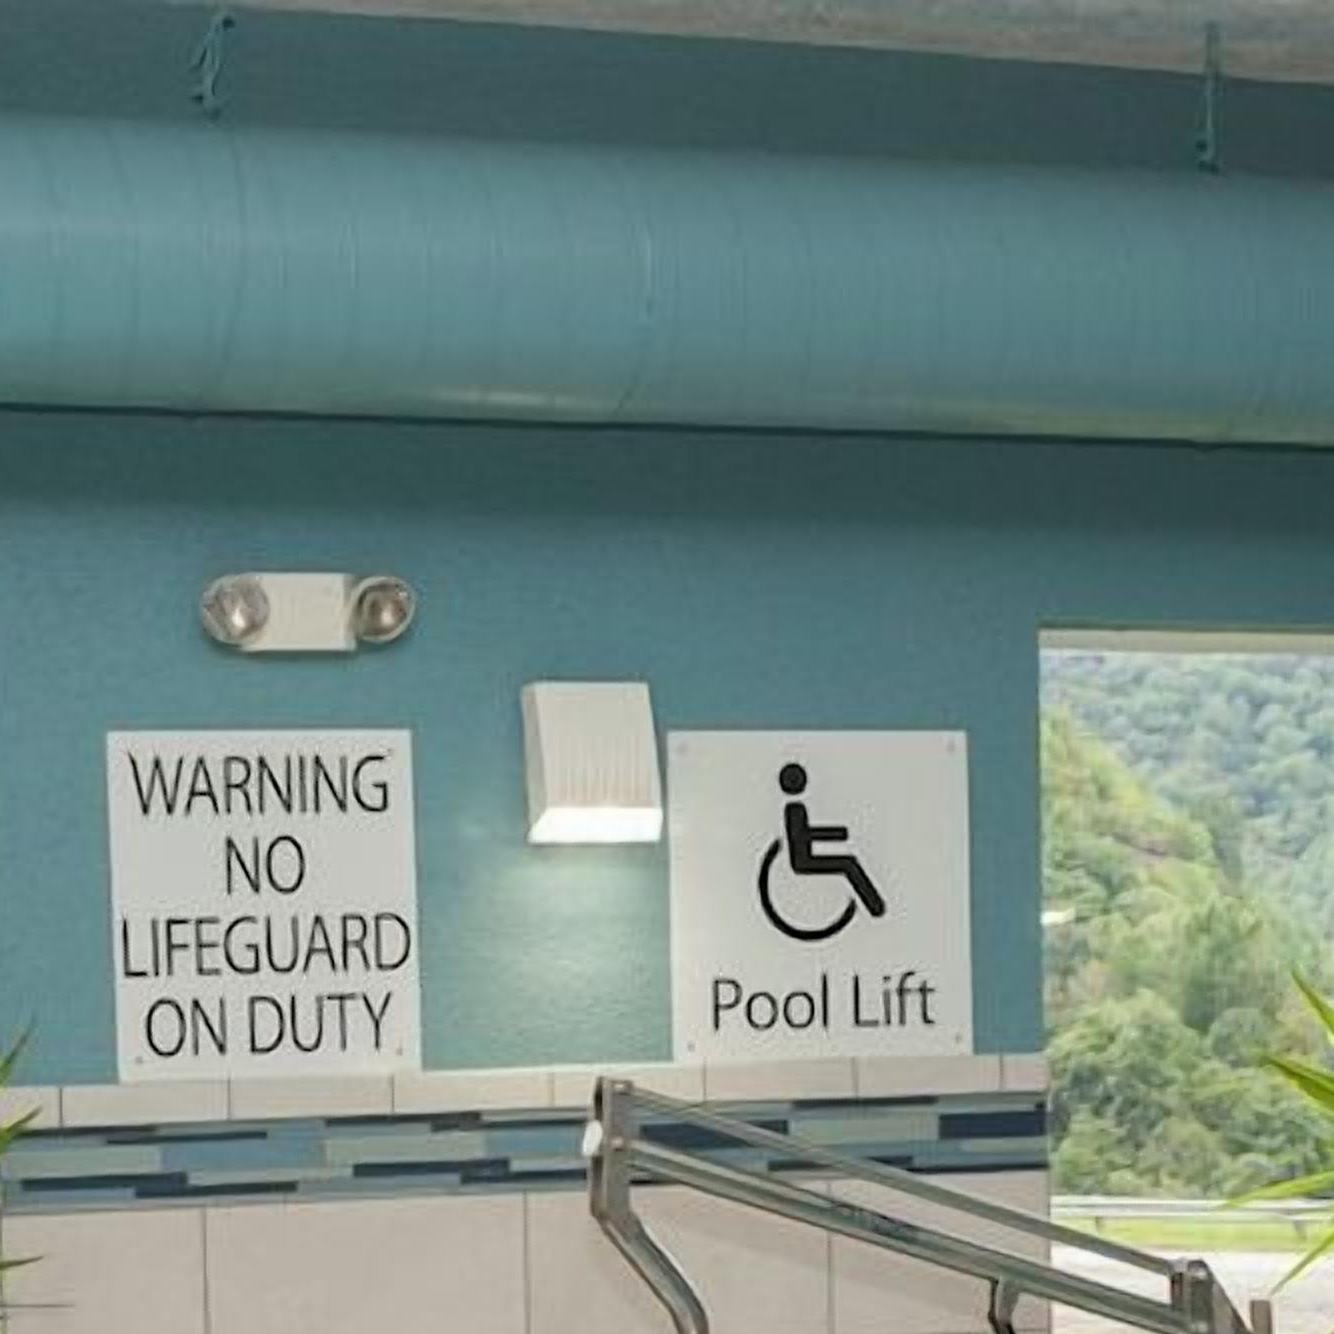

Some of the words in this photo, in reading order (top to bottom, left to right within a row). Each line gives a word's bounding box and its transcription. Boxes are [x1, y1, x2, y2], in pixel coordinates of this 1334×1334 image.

[128, 753, 391, 817] WARNING
[224, 835, 305, 895] NO
[122, 911, 411, 977] LIFEGUARD
[145, 997, 228, 1057] ON
[248, 992, 392, 1055] DUTY
[712, 973, 830, 1030] Pool
[854, 971, 935, 1028] Lift
